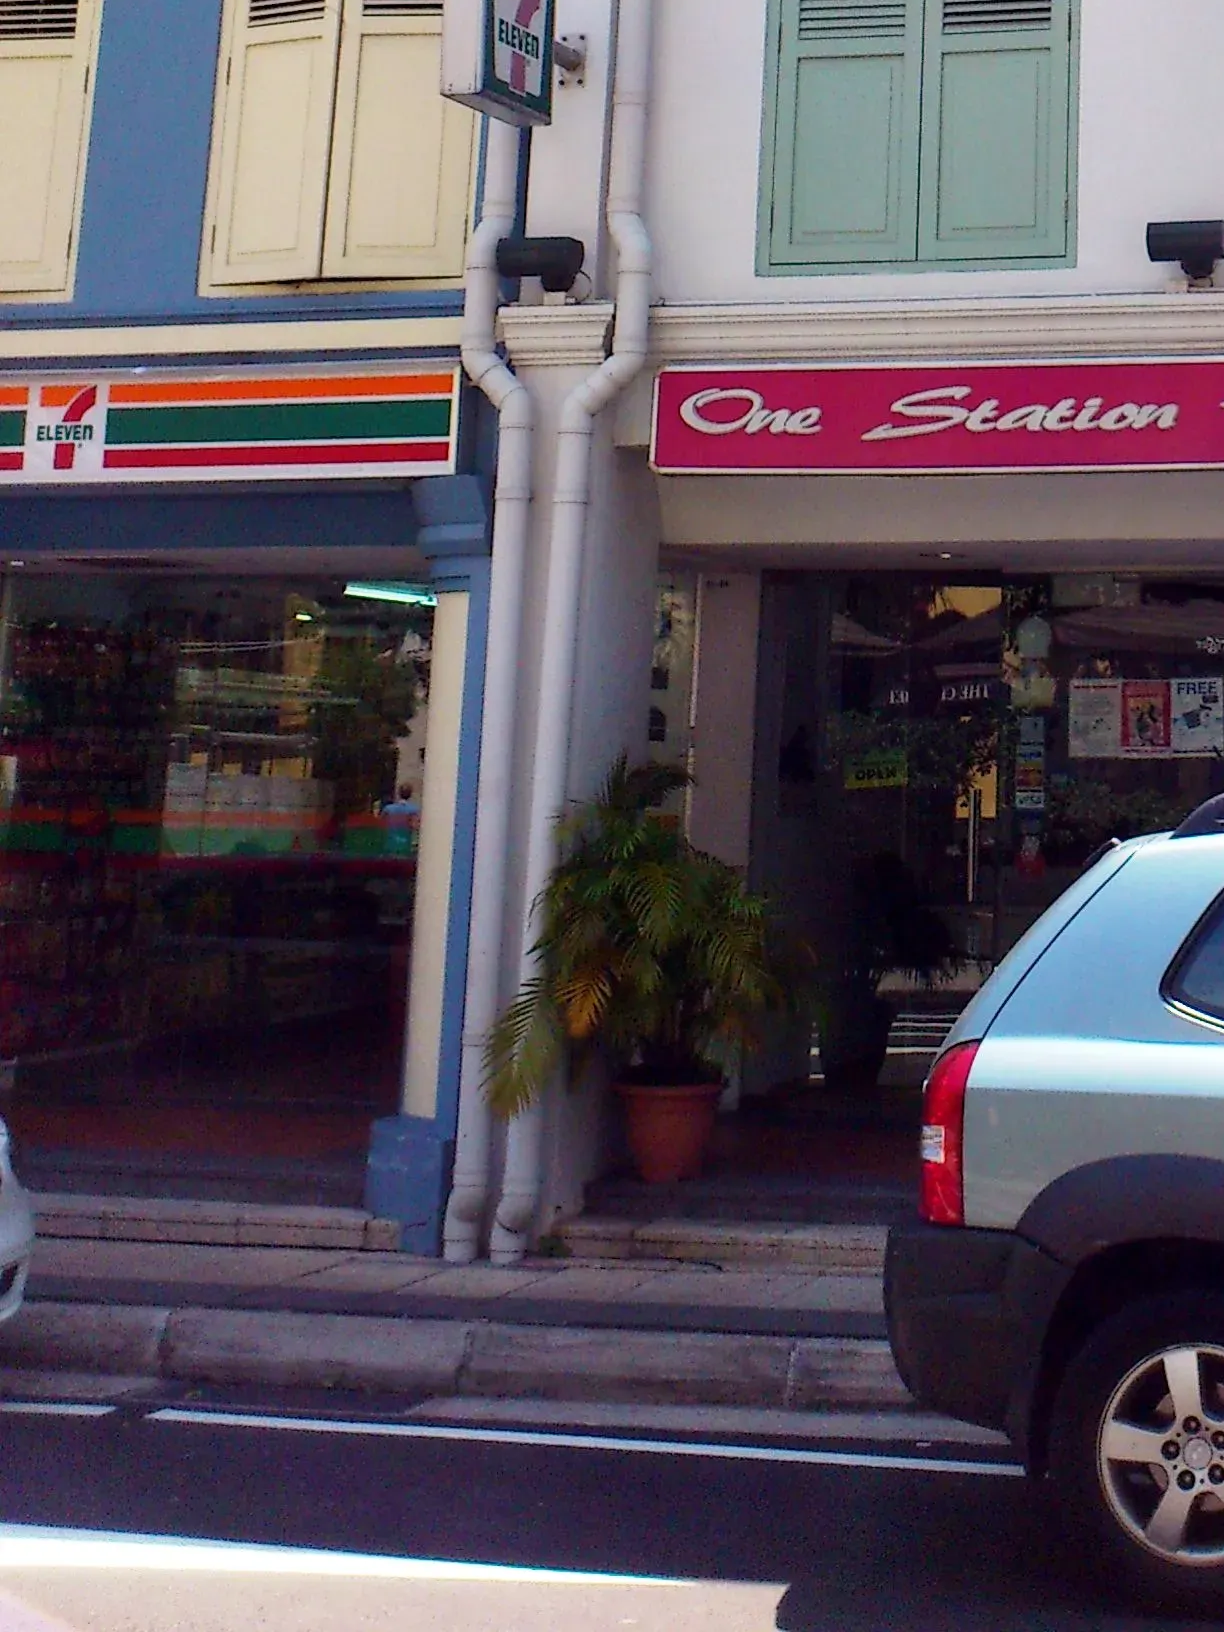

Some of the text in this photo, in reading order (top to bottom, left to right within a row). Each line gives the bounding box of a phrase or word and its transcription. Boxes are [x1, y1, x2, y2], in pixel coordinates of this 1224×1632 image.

[679, 386, 823, 437] One
[859, 384, 1180, 442] Station
[1176, 680, 1218, 696] FREE
